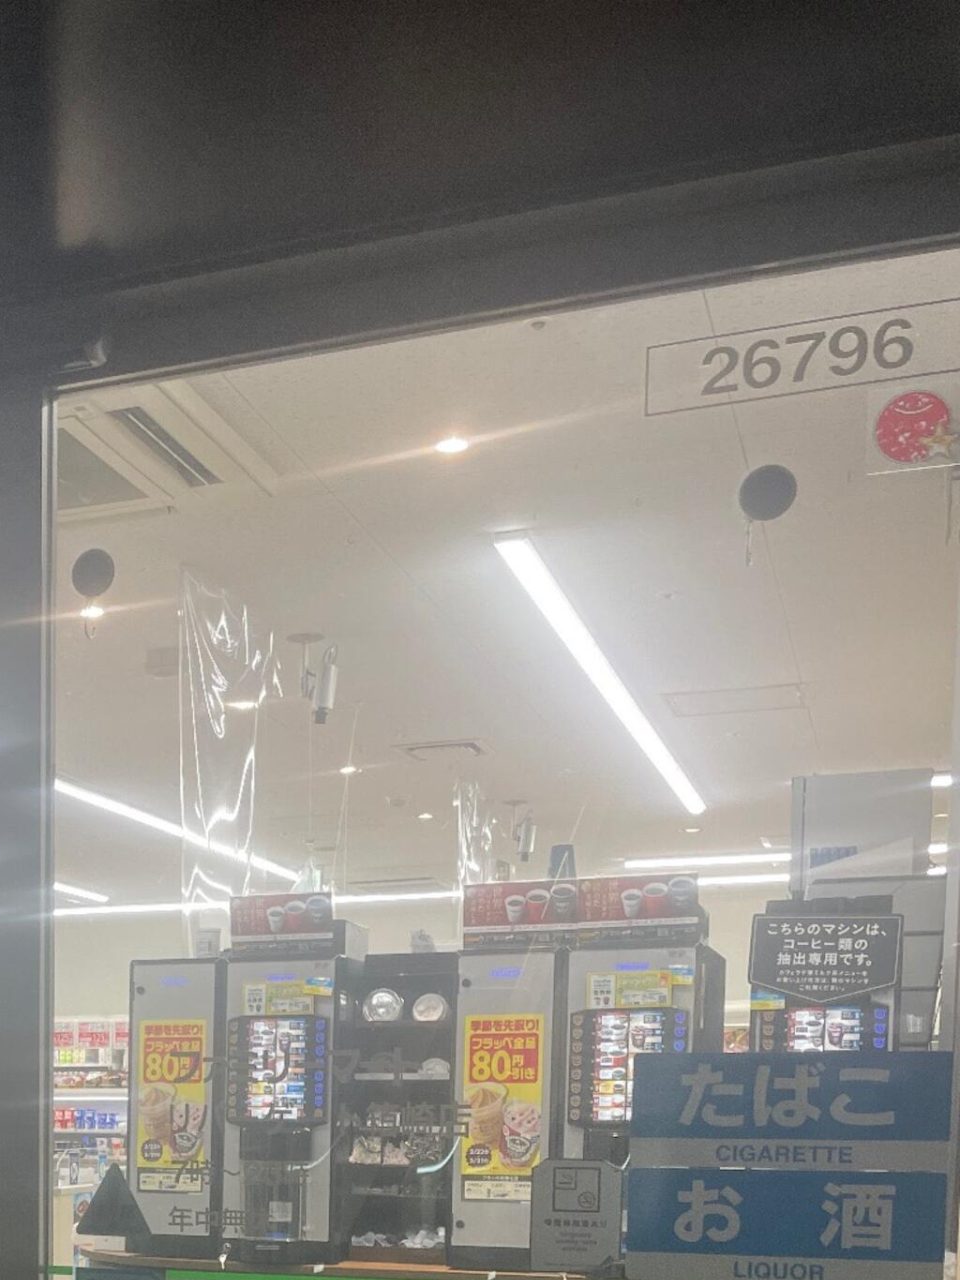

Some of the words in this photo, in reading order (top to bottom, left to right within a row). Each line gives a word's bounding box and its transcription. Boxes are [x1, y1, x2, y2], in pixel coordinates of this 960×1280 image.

[700, 318, 914, 396] 26796
[471, 1050, 512, 1081] 80
[678, 1062, 896, 1128] たばこ
[715, 1144, 853, 1165] CIGARETTE
